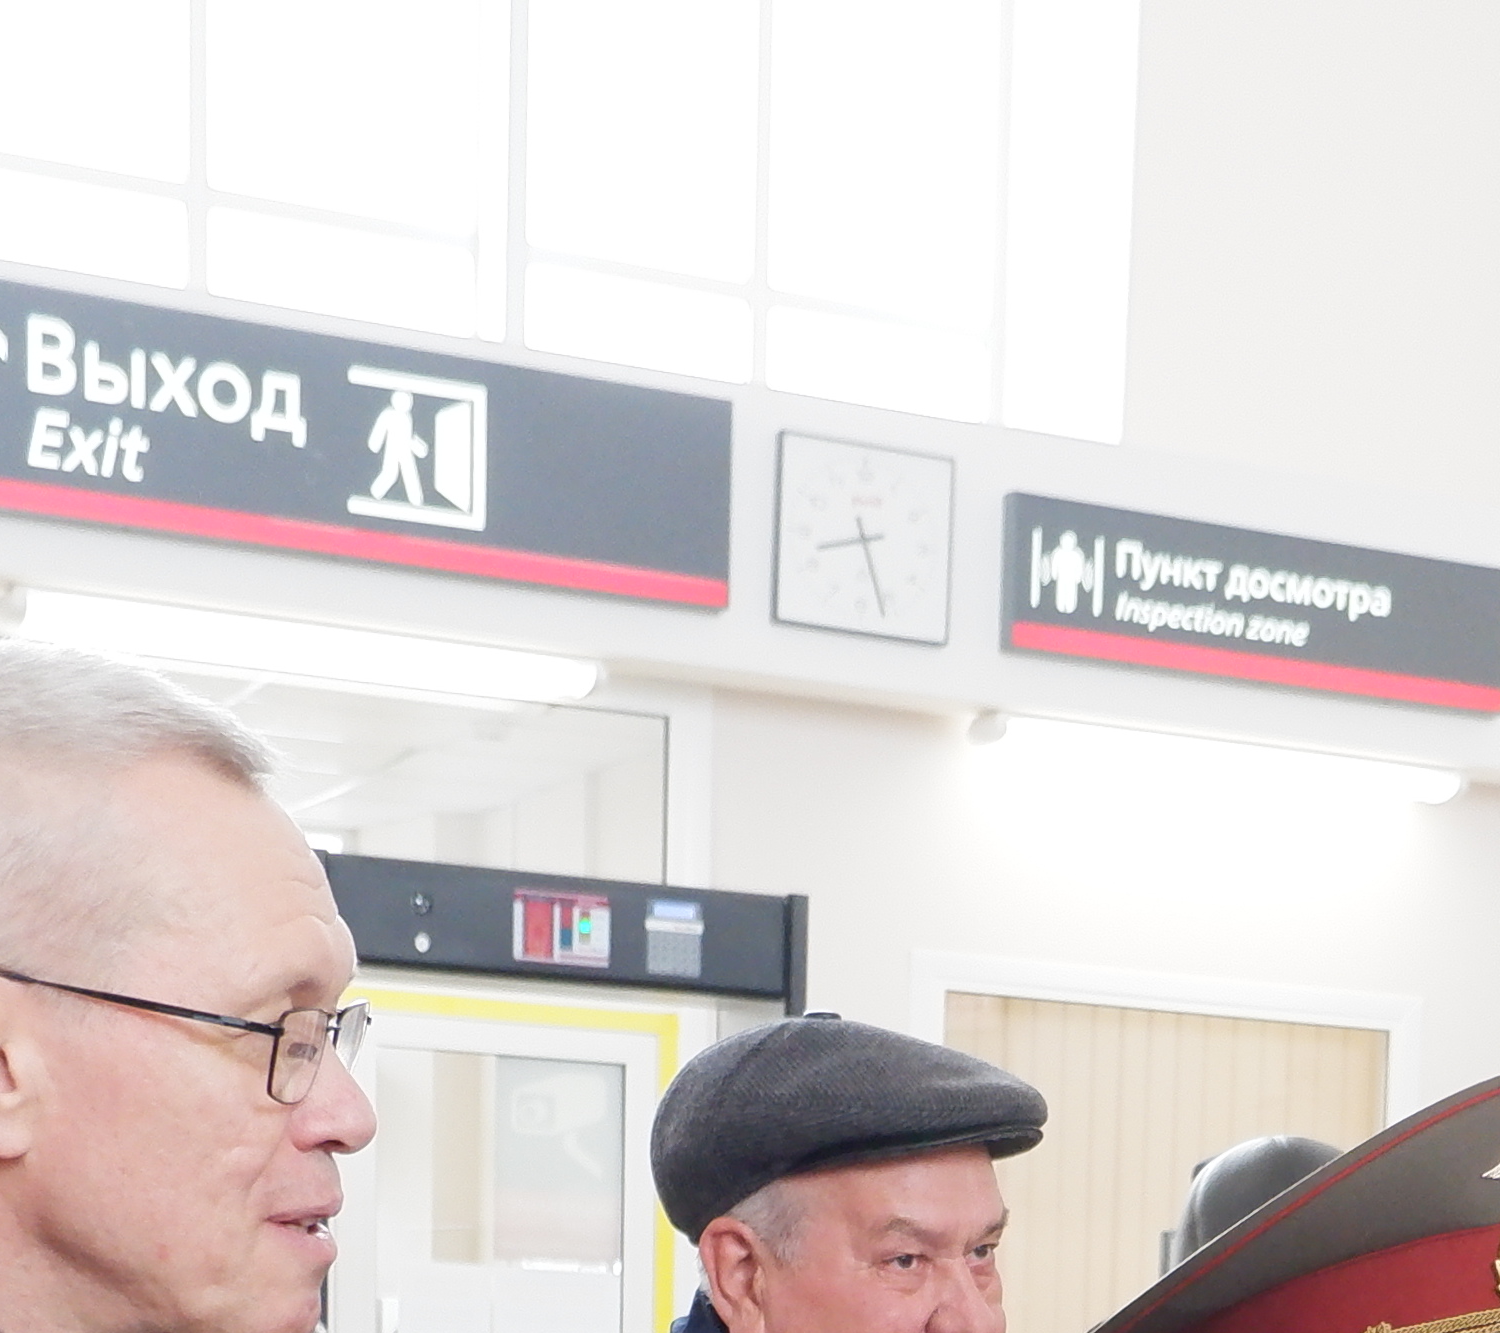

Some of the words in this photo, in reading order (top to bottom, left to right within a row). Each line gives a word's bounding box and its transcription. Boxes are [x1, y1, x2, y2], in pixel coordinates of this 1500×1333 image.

[26, 312, 308, 448] Выход
[26, 407, 151, 483] Exit
[1113, 590, 1245, 638] Inspection
[1244, 614, 1311, 648] zone
[1114, 537, 1222, 592] Пункт
[1223, 564, 1393, 621] досмотра
